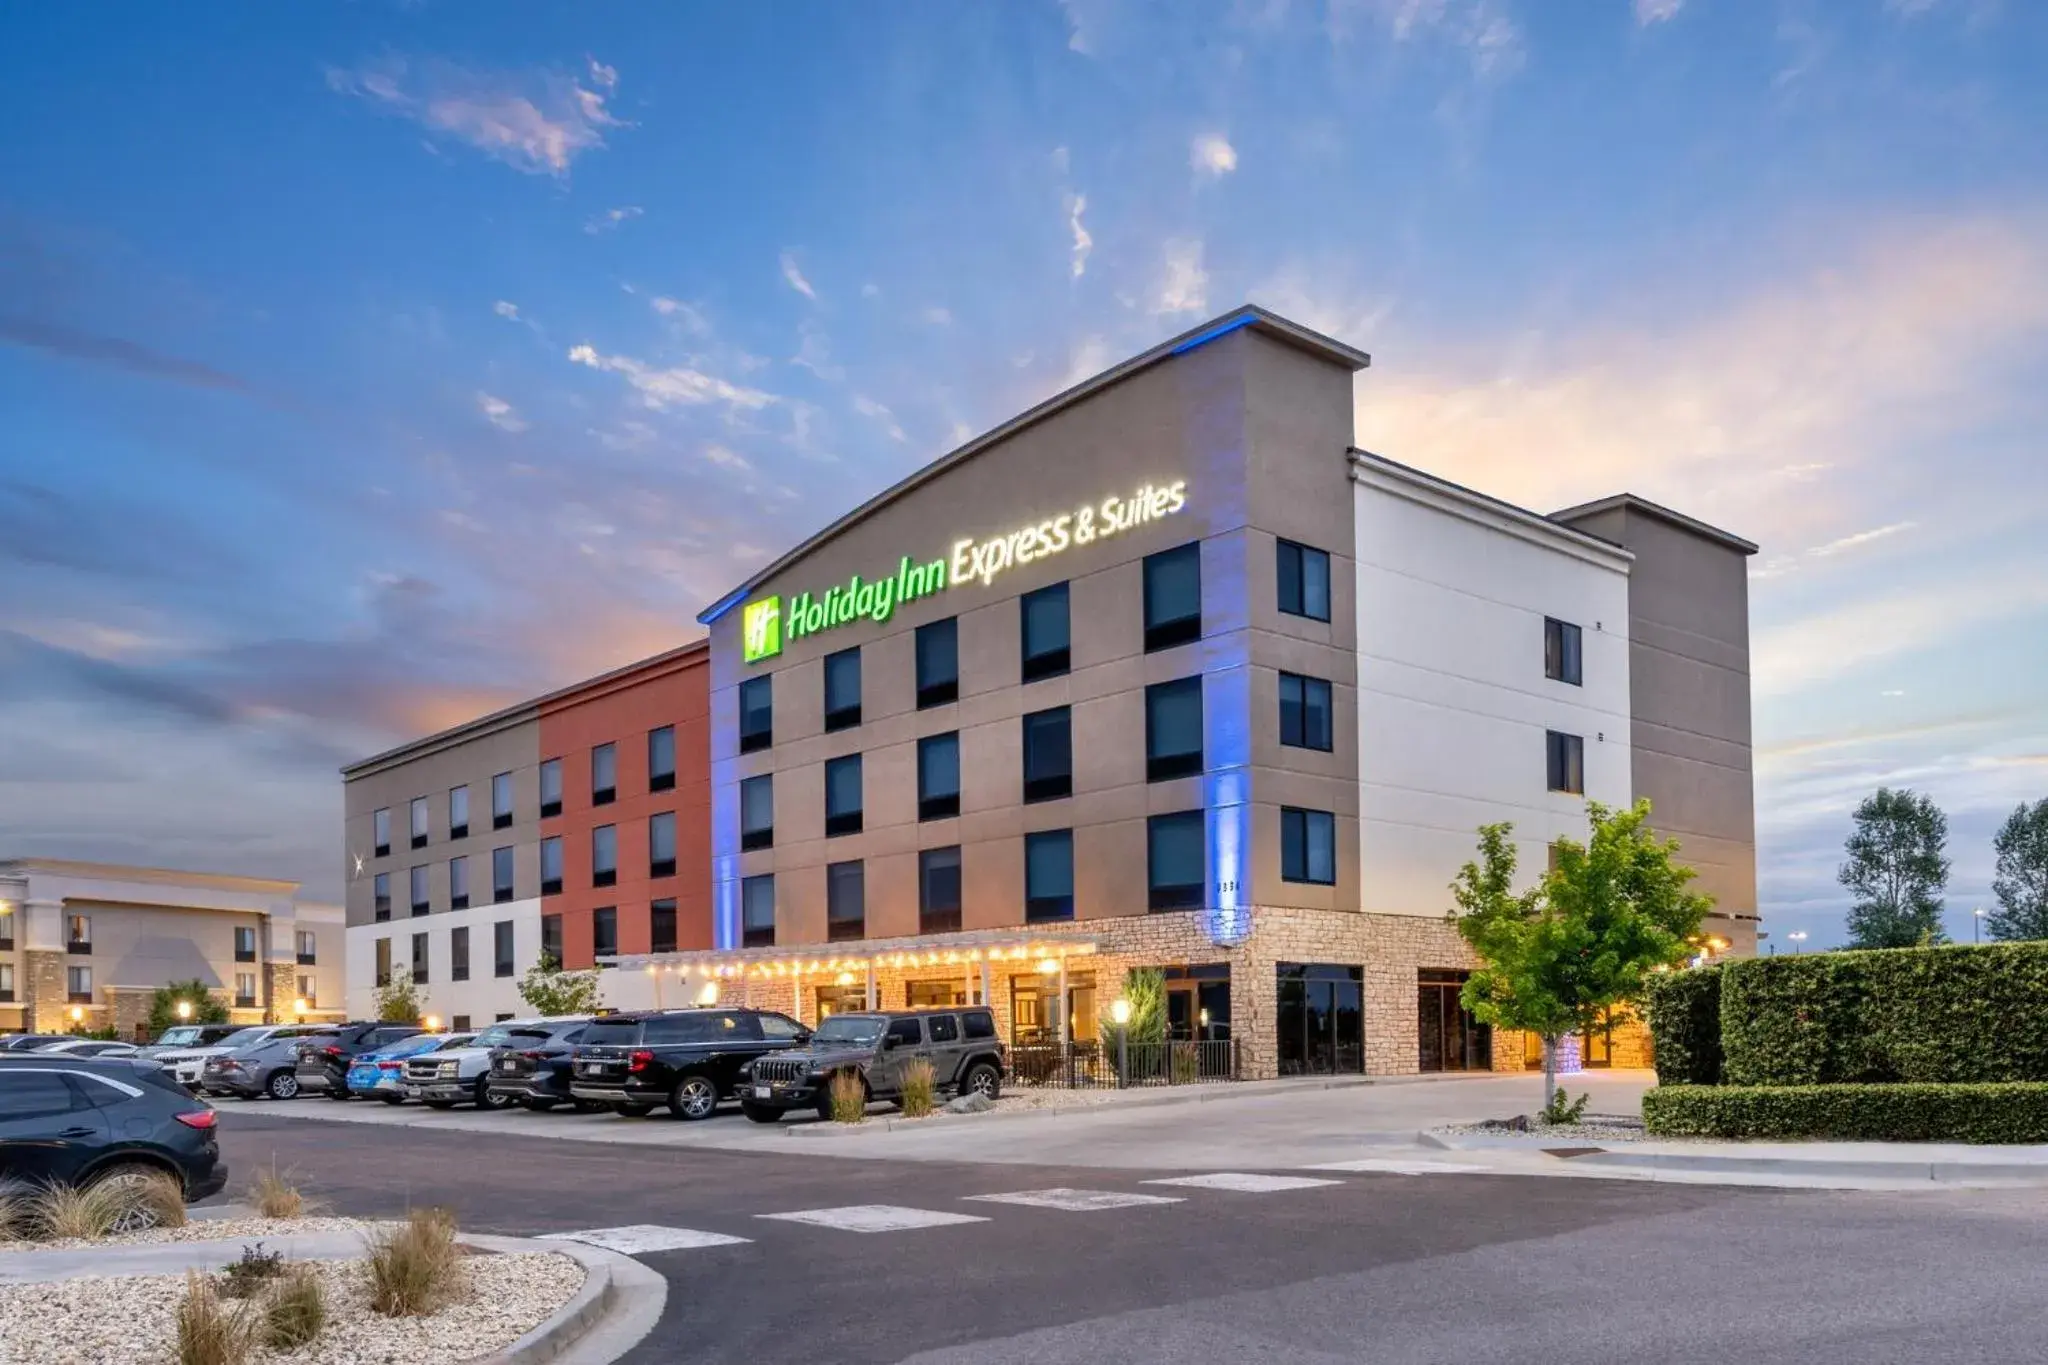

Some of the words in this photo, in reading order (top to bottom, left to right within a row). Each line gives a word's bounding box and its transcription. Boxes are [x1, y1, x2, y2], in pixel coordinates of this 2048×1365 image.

[787, 576, 895, 640] Holiday
[897, 556, 946, 603] Inn
[950, 515, 1071, 586] Express
[1074, 506, 1097, 545] &
[1099, 481, 1187, 536] Suites
